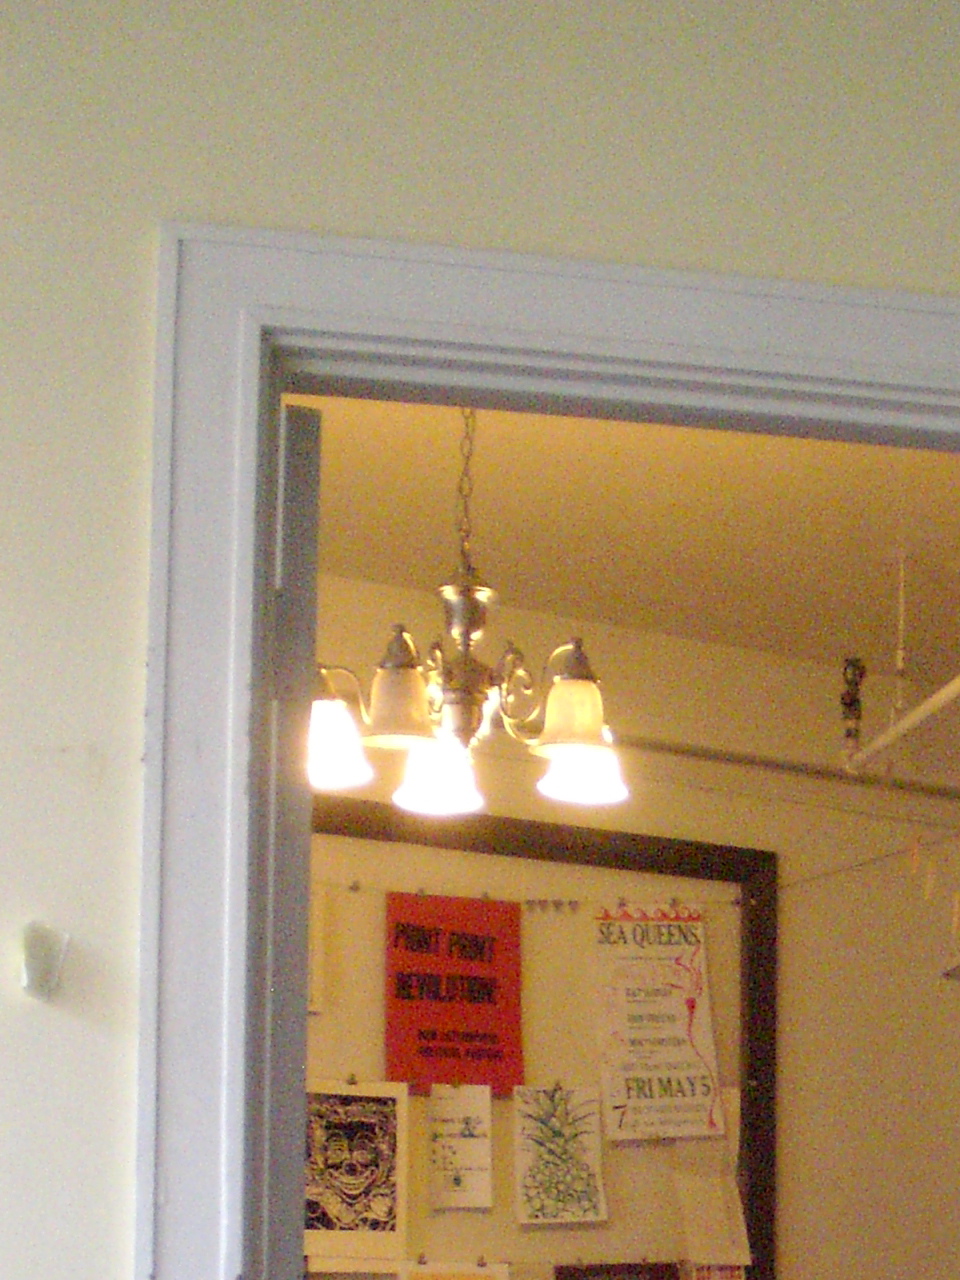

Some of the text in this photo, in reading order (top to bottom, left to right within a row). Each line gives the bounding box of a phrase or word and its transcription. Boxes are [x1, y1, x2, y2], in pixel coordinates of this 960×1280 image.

[599, 923, 702, 948] SEA QUEENS
[625, 1077, 654, 1100] FRI
[657, 1077, 697, 1098] MAY
